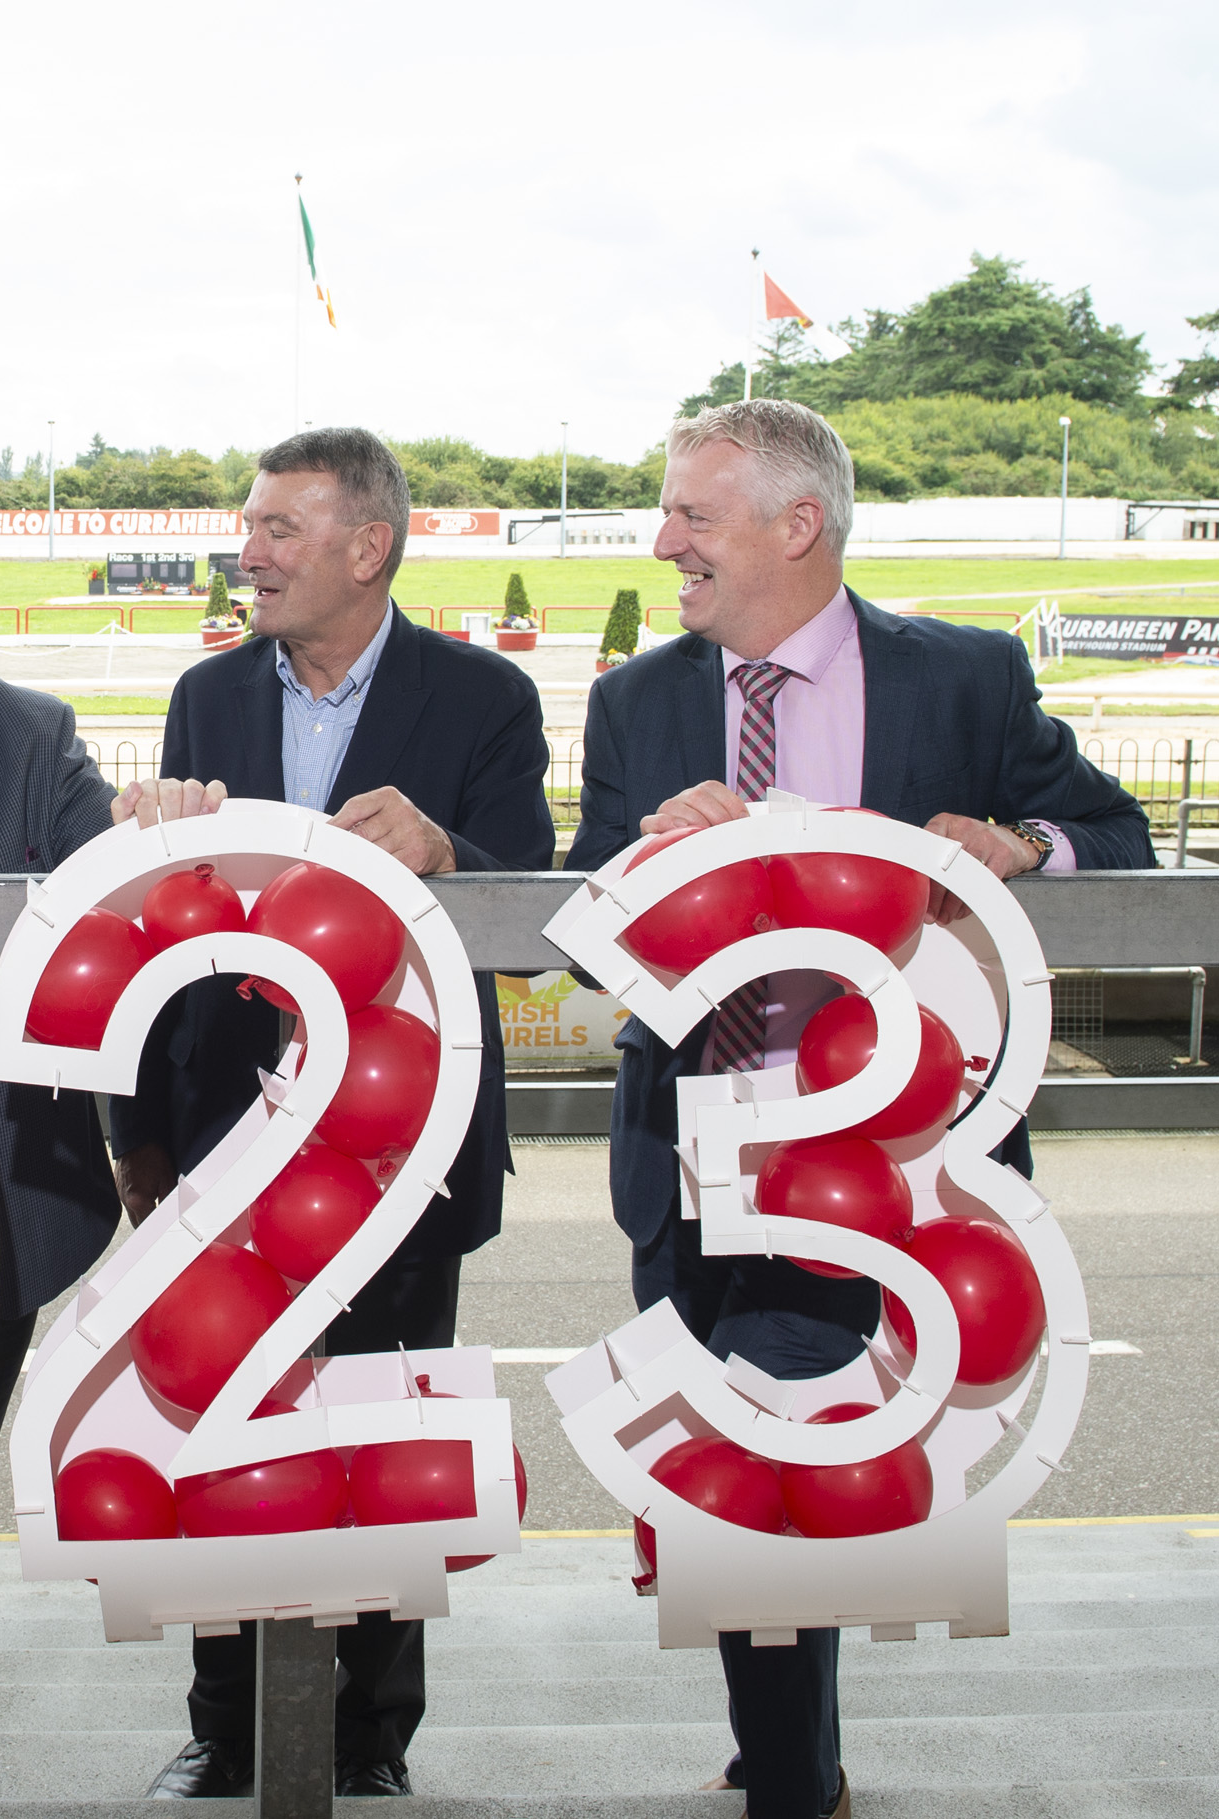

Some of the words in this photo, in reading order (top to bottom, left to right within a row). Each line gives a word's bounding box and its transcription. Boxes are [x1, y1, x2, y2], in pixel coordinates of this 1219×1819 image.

[78, 513, 106, 534] TO
[110, 513, 237, 534] CURRAHEEN
[108, 553, 134, 562] Race
[141, 553, 156, 562] 1st
[157, 553, 177, 562] 2nd
[178, 553, 195, 562] 3rd
[1062, 640, 1118, 652] GREYHOUND
[1119, 642, 1167, 653] STADIUM
[499, 1002, 559, 1024] RISH
